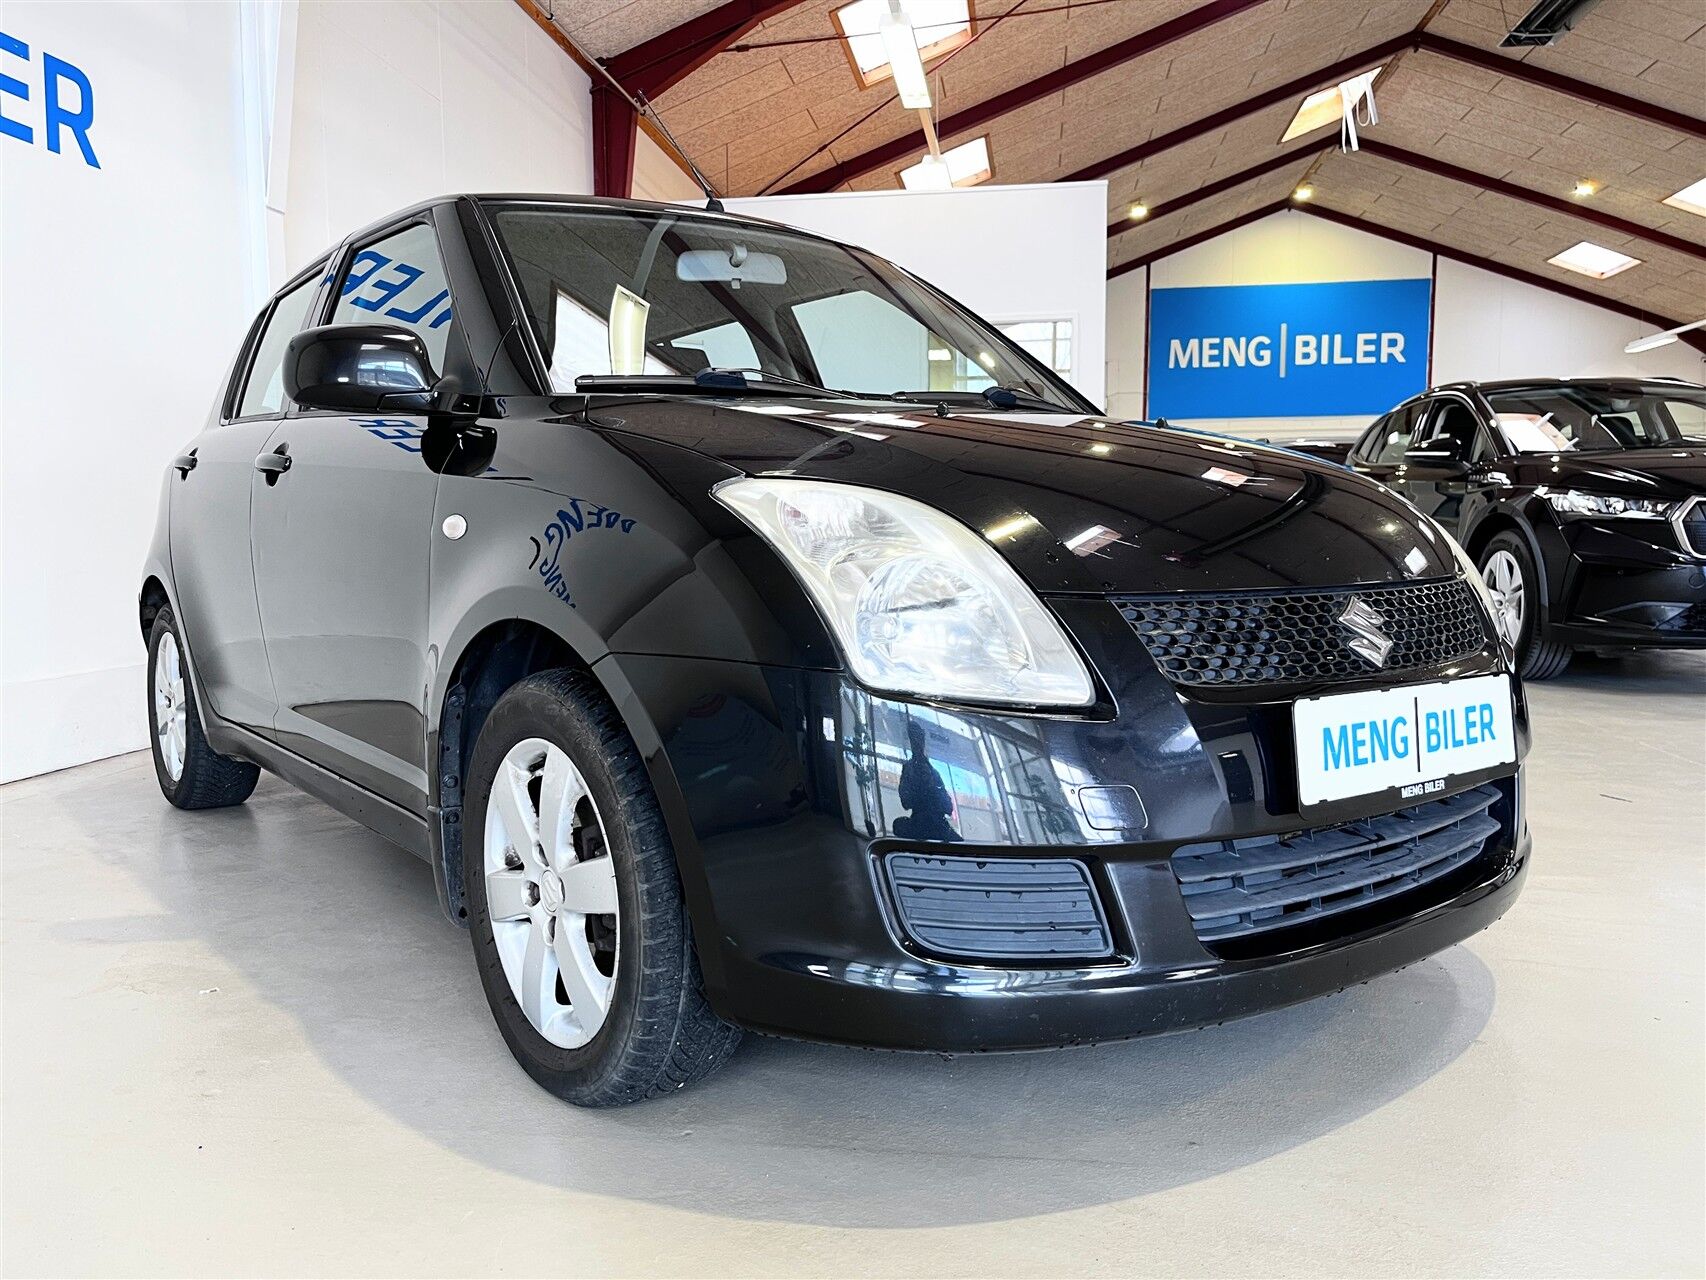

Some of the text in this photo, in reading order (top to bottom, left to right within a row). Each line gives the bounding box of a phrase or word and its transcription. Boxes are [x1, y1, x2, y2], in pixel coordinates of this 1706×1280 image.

[1168, 332, 1406, 369] MENG BILER
[1323, 703, 1496, 771] MENG BILER
[1401, 779, 1445, 799] MENG BILER
